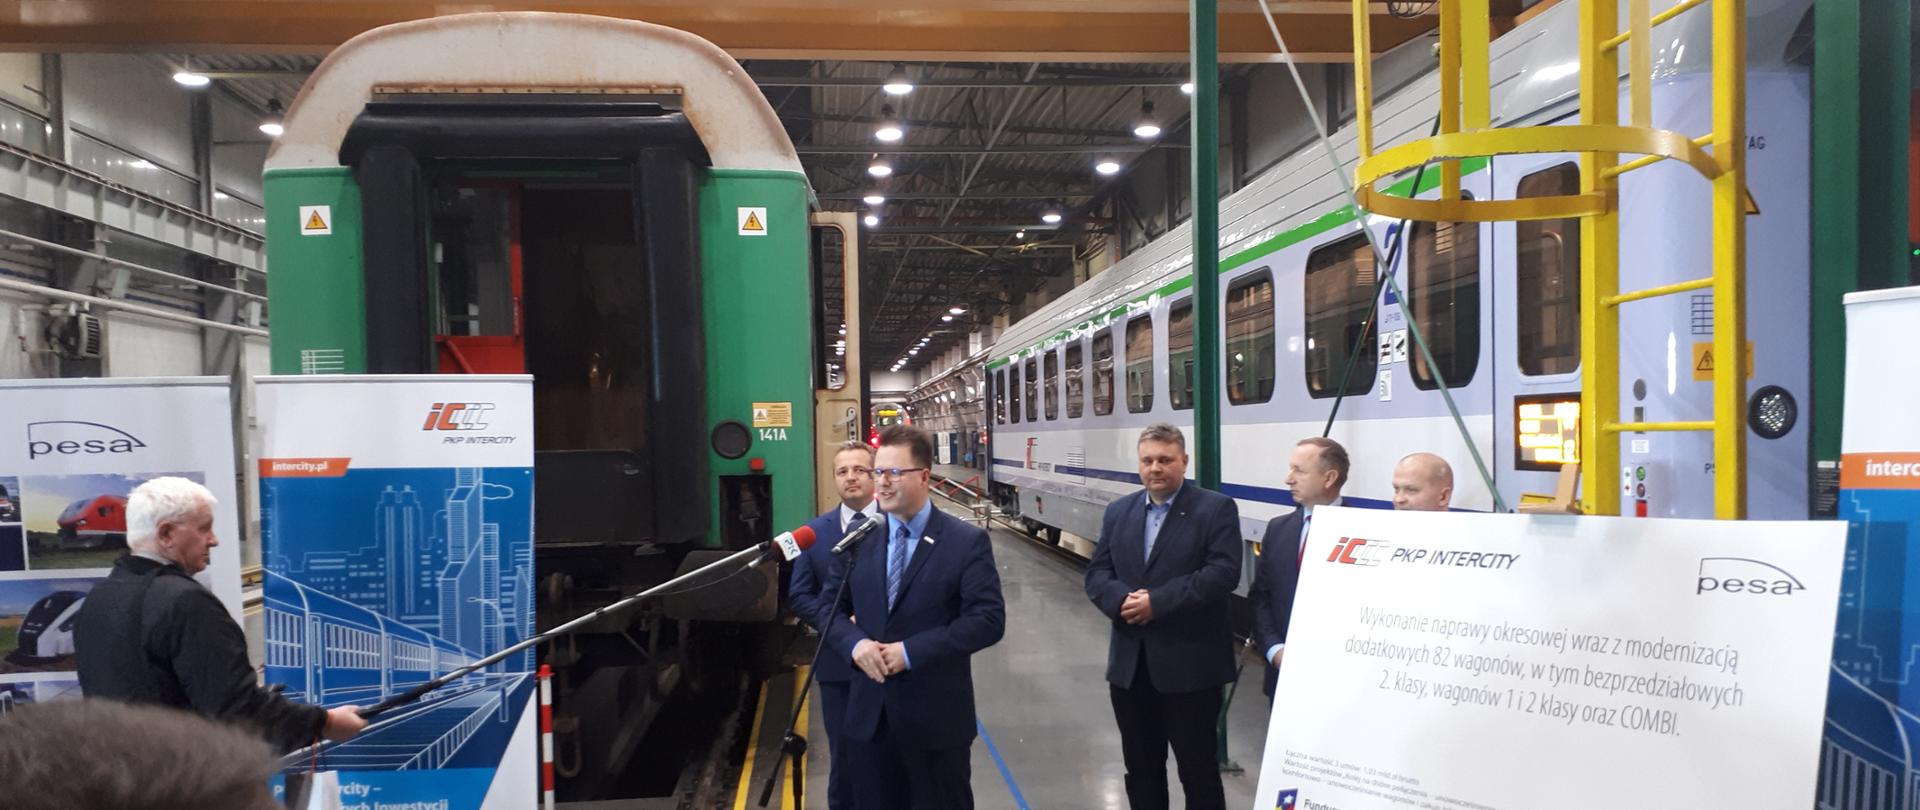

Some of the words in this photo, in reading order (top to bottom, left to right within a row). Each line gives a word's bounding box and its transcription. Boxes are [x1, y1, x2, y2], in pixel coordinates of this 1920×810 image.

[442, 436, 464, 445] PKP
[466, 436, 516, 445] INTERCITY
[759, 428, 787, 441] 141A
[28, 439, 133, 460] pesa
[272, 461, 328, 473] intercity.pl
[1390, 547, 1428, 563] PKP
[1428, 550, 1520, 570] INTERCITY
[1696, 576, 1792, 595] pesa
[1359, 606, 1429, 632] Wykonanie
[1431, 618, 1491, 644] naprawy
[1493, 621, 1569, 654] okresowej
[1571, 633, 1609, 654] wraz
[1611, 637, 1622, 655] z
[1625, 636, 1739, 675] modernizacją
[1345, 634, 1430, 666] dodatkowych
[1432, 645, 1451, 667] 82
[1454, 653, 1526, 681] wagonów,
[1531, 663, 1546, 680] w
[1549, 662, 1580, 687] tym
[1583, 664, 1744, 710] bezprzedziałowych
[1379, 669, 1391, 690] 2.
[1394, 672, 1428, 700] klasy,
[1433, 681, 1502, 706] wagonów
[1506, 688, 1514, 709] 1
[1517, 690, 1524, 710] i
[1525, 691, 1537, 713] 2
[1539, 693, 1579, 725] klasy
[1582, 704, 1617, 726] oraz
[1620, 704, 1680, 737] COMBI.
